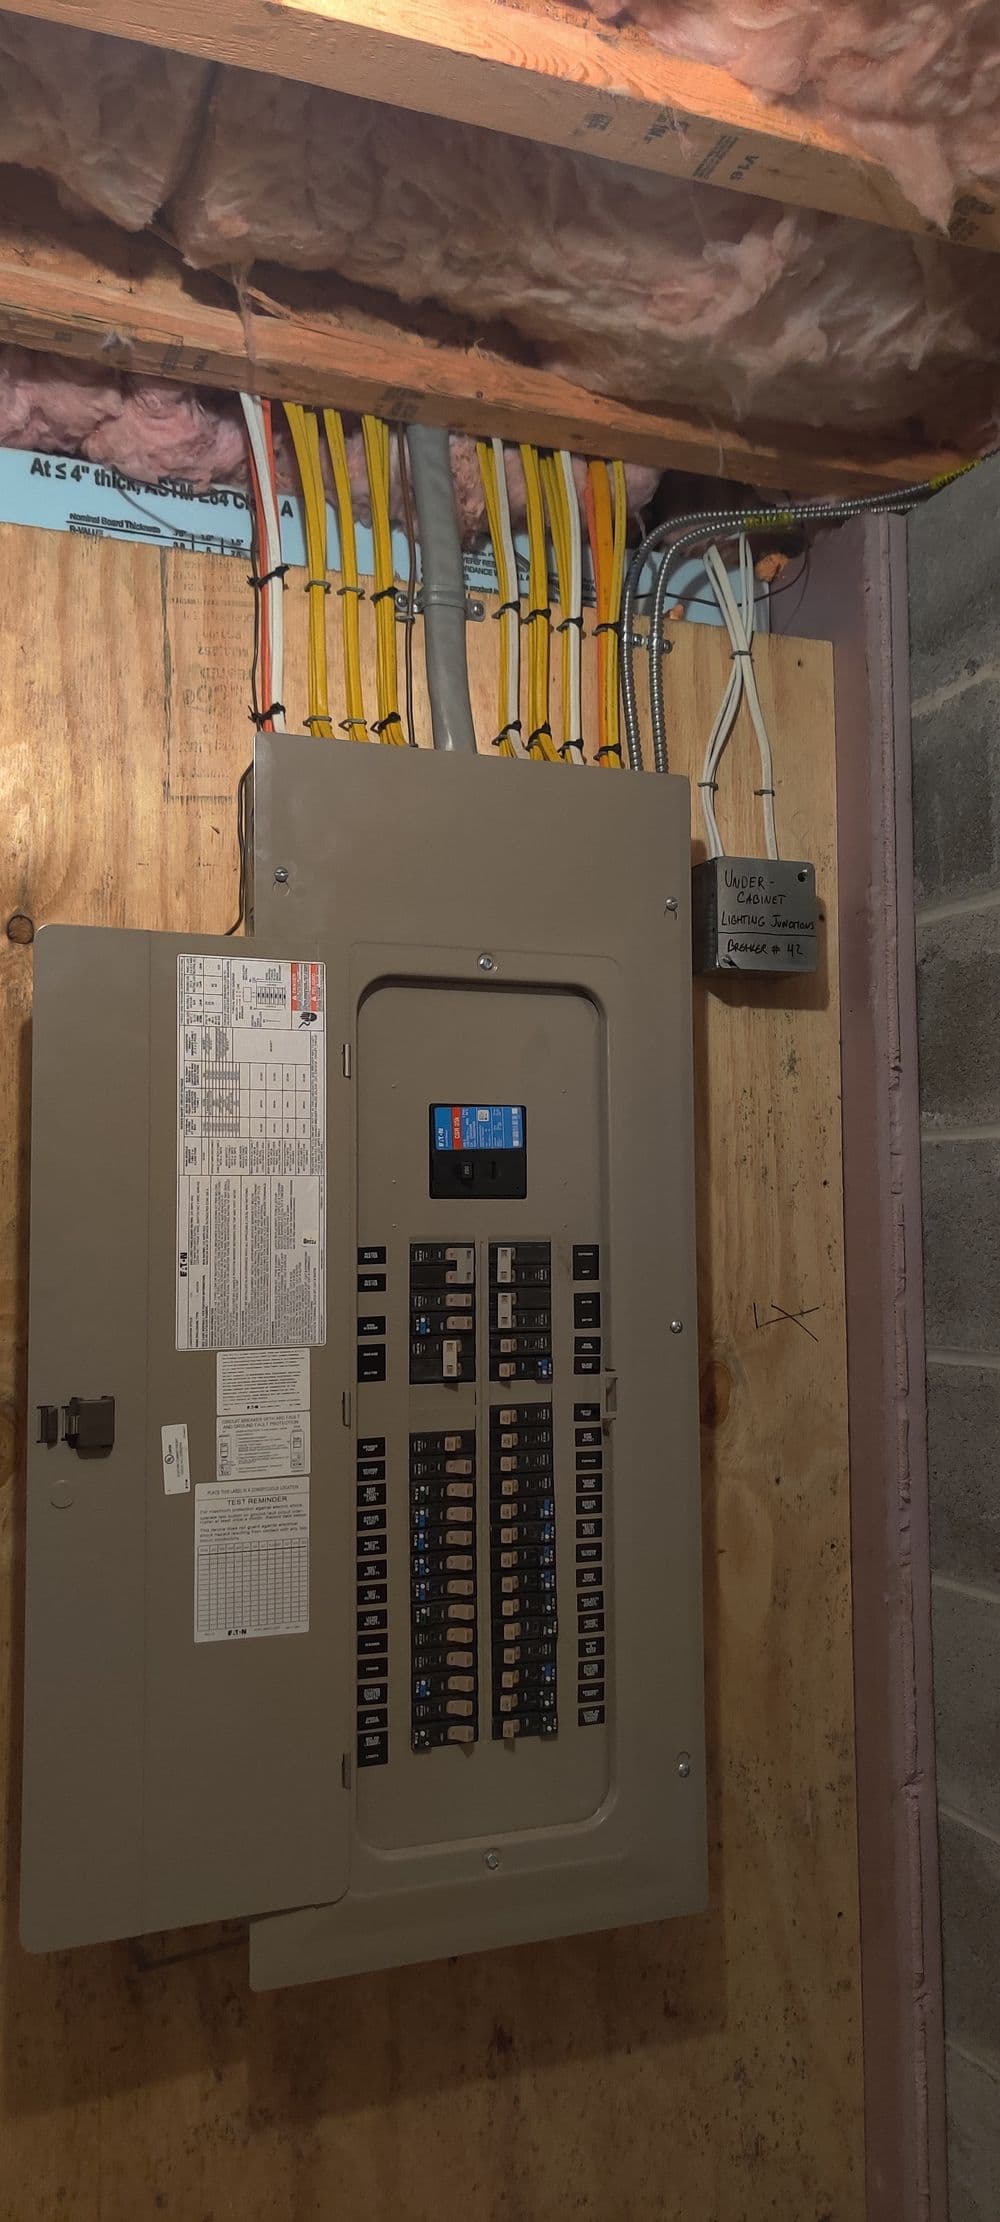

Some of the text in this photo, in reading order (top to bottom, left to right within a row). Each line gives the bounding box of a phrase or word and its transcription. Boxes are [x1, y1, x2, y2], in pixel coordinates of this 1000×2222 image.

[30, 457, 51, 477] At
[70, 465, 90, 482] 4"
[94, 467, 141, 496] thick,
[69, 512, 100, 524] Nominal
[101, 517, 124, 528] Board
[736, 891, 787, 905] CABINET
[721, 911, 815, 930] LIGHTING JUNCTIONS
[727, 939, 803, 957] BREAKER # 42
[227, 1495, 288, 1506] TEST REMINDER
